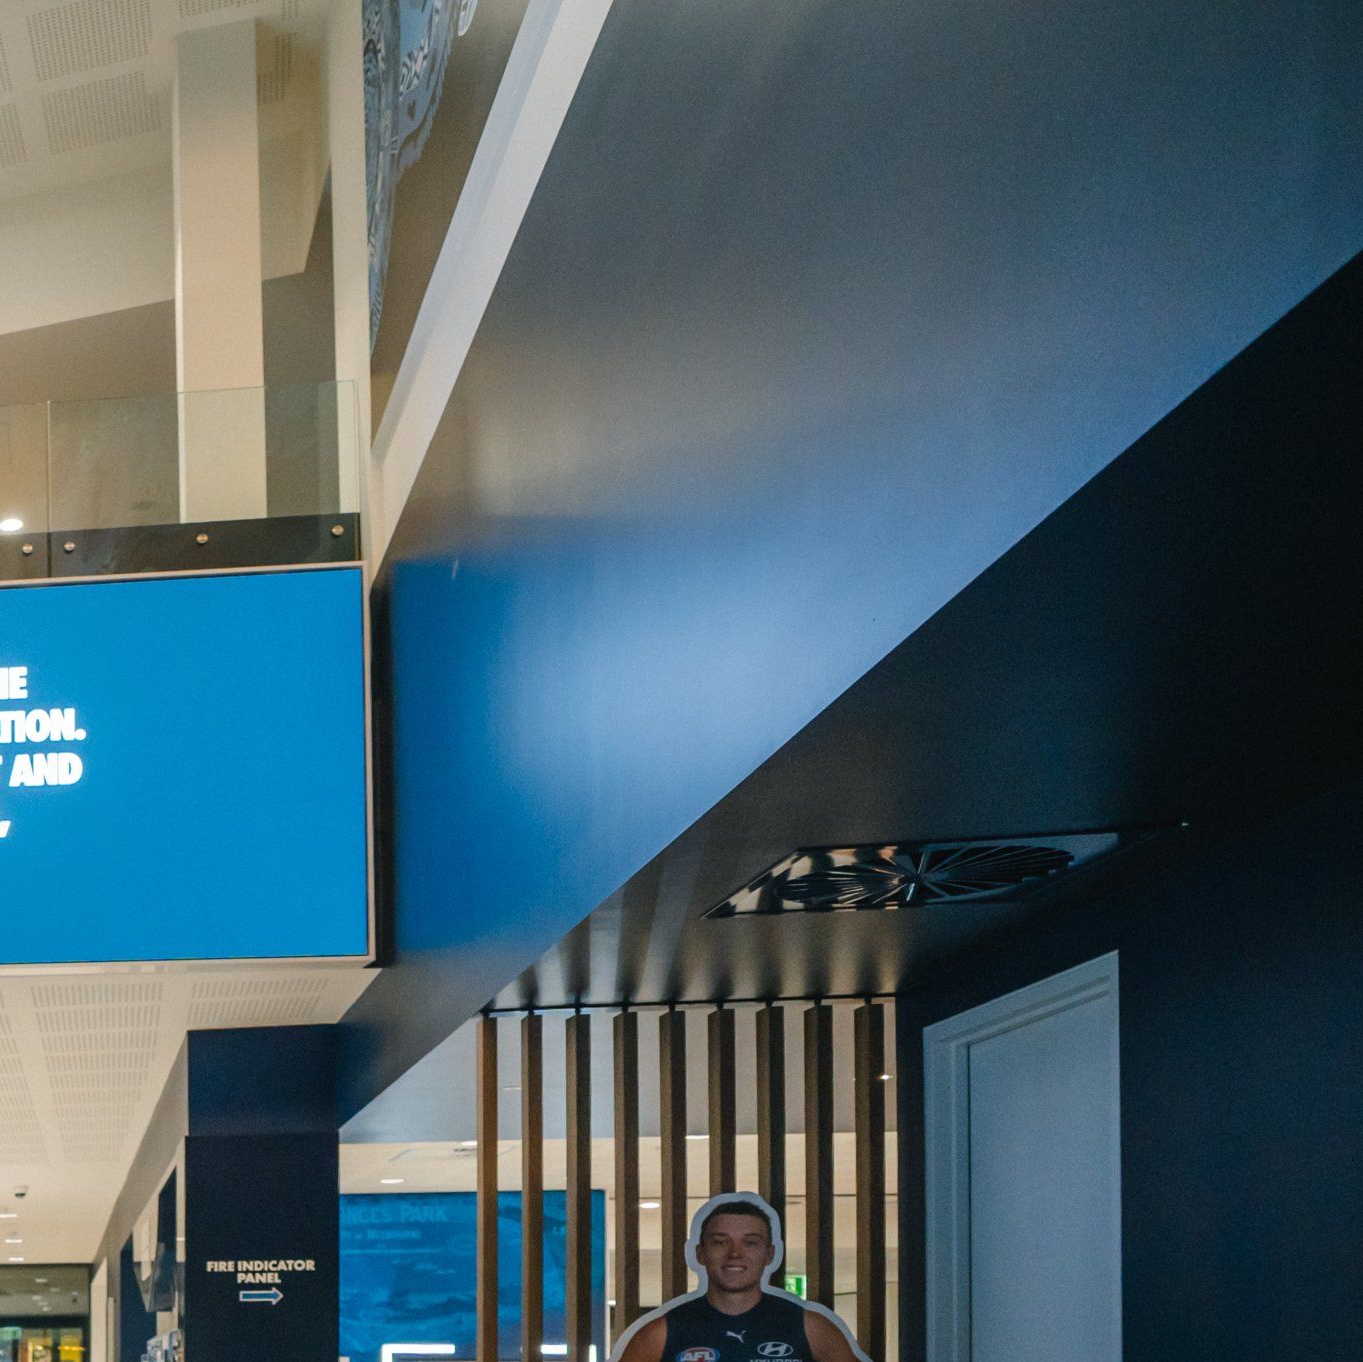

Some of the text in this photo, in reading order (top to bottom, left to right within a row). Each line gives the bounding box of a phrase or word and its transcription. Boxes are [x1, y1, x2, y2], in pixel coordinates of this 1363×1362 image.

[8, 751, 83, 787] AND
[206, 1260, 315, 1272] FIRE INDICATOR
[237, 1273, 281, 1283] PANEL
[681, 1350, 715, 1362] AFL
